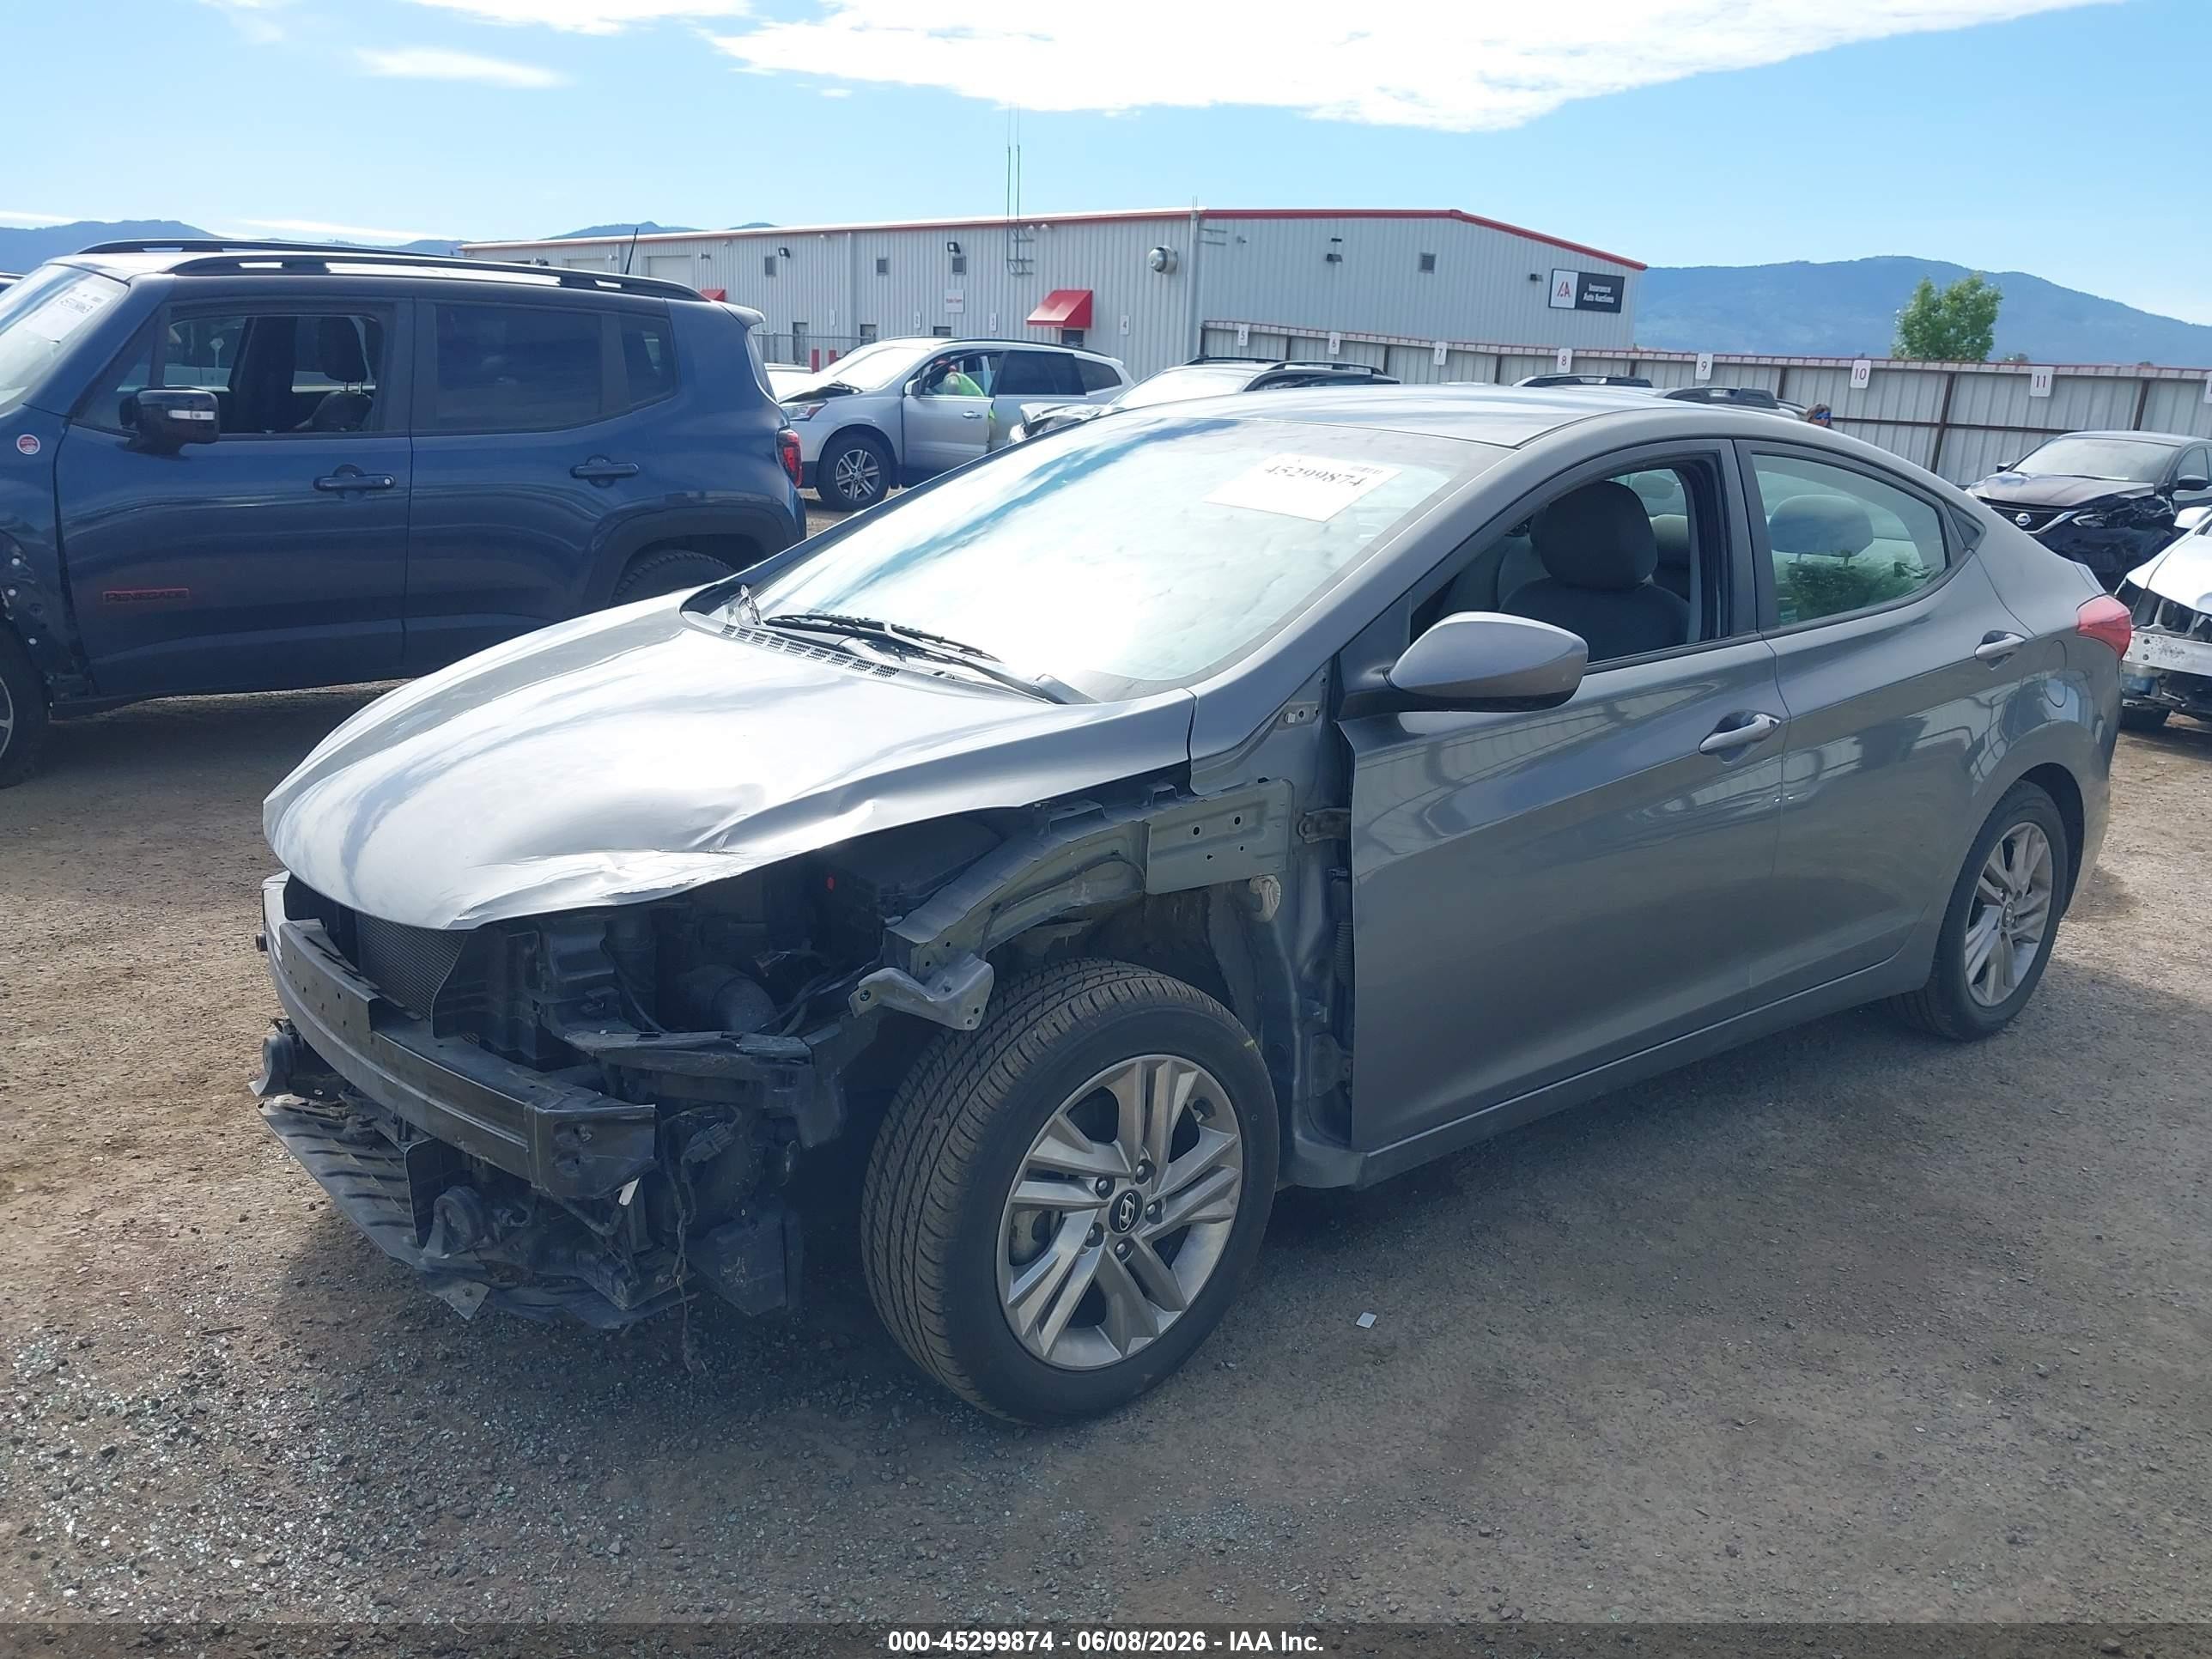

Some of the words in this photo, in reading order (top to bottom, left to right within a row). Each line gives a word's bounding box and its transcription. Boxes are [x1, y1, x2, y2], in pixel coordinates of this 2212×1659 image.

[1240, 330, 1245, 341] 5
[1331, 337, 1336, 348] 6
[1437, 348, 1443, 358] 7
[1561, 355, 1567, 366] 8
[1701, 361, 1707, 372] 9
[1854, 368, 1867, 380] 10
[2036, 374, 2046, 388] 11
[104, 588, 187, 602] RENEGADE
